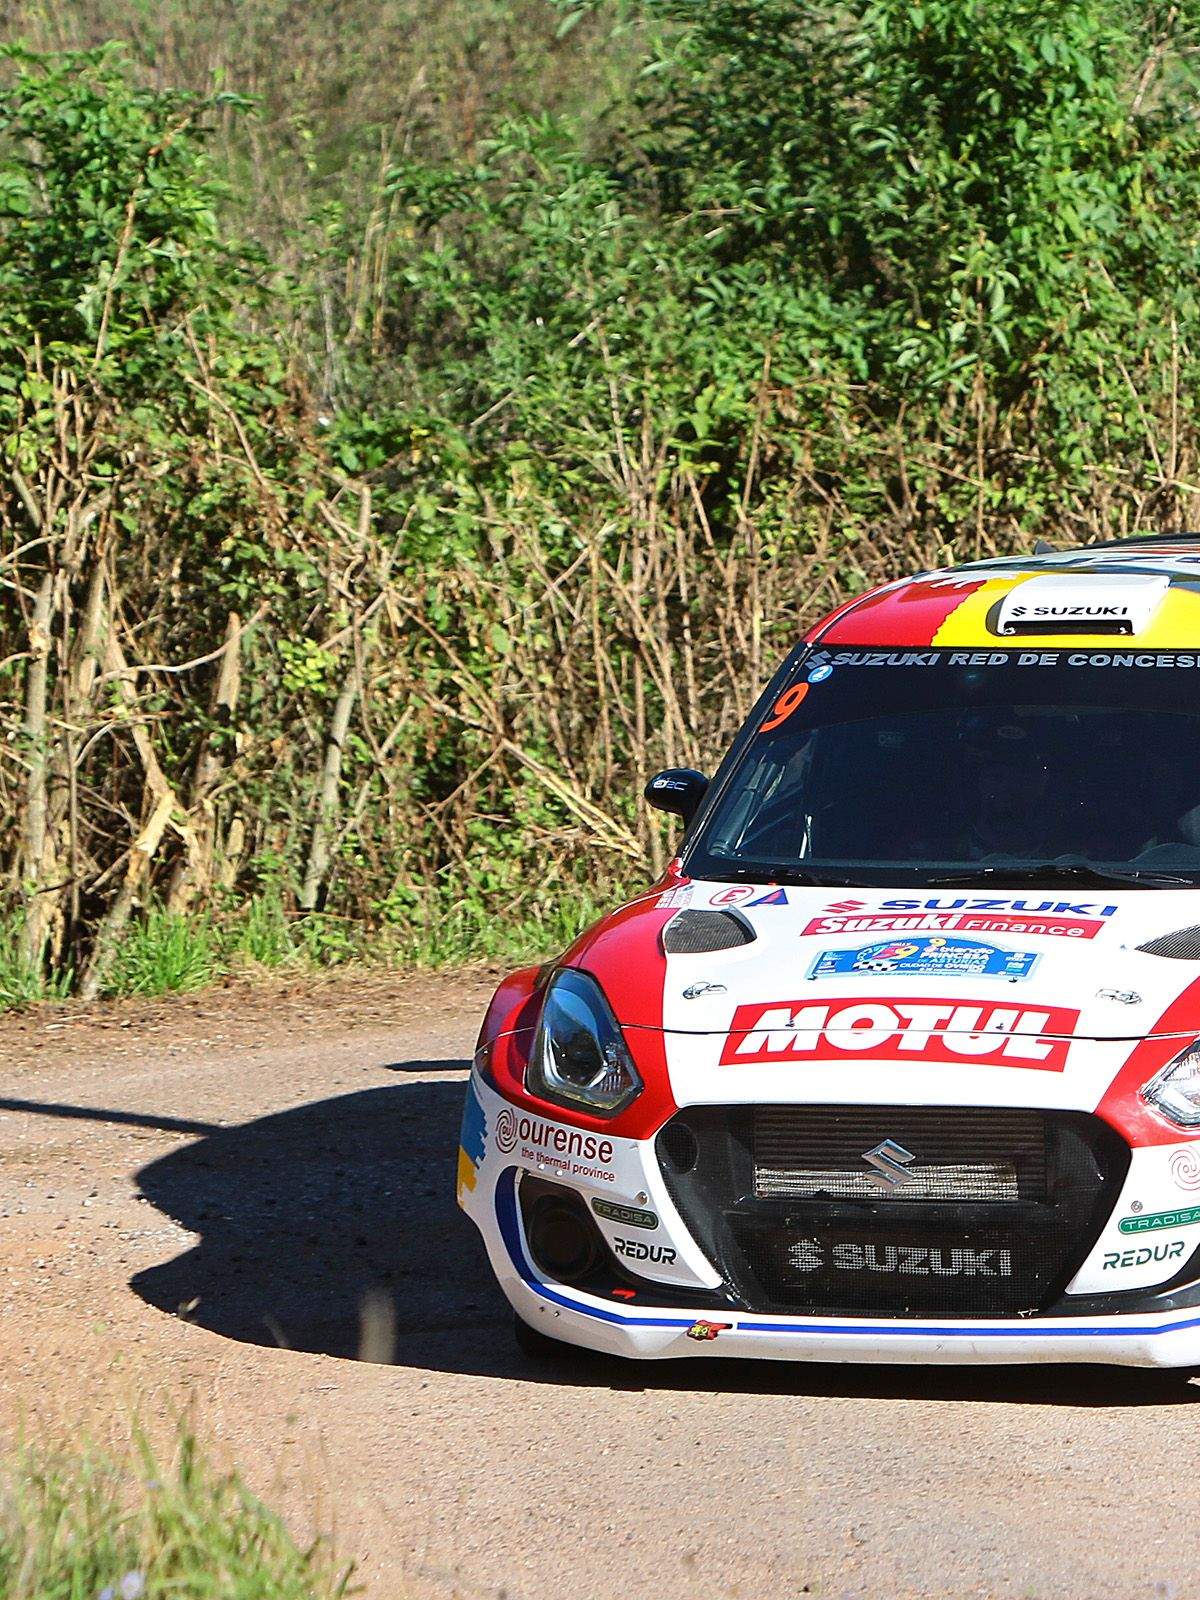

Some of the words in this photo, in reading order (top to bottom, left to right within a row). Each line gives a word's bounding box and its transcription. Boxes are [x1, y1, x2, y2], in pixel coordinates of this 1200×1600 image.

[1034, 606, 1128, 616] SUZUKI
[831, 652, 938, 667] SUZUKI
[949, 653, 1009, 666] RED
[1023, 653, 1060, 667] DE
[759, 682, 809, 732] 9
[878, 899, 1119, 917] SUZUKI
[815, 913, 964, 934] Suzuki
[920, 952, 990, 960] PRINCESA
[930, 957, 987, 965] ASTURIAS
[734, 1003, 1060, 1060] MOTUL
[519, 1118, 613, 1164] ourense
[521, 1147, 534, 1160] the
[536, 1151, 571, 1171] thermal
[572, 1164, 616, 1182] province
[595, 1204, 652, 1224] TRADISA
[613, 1236, 677, 1265] REDUR
[832, 1243, 1012, 1276] SUZUKI
[1103, 1241, 1185, 1270] REDUR
